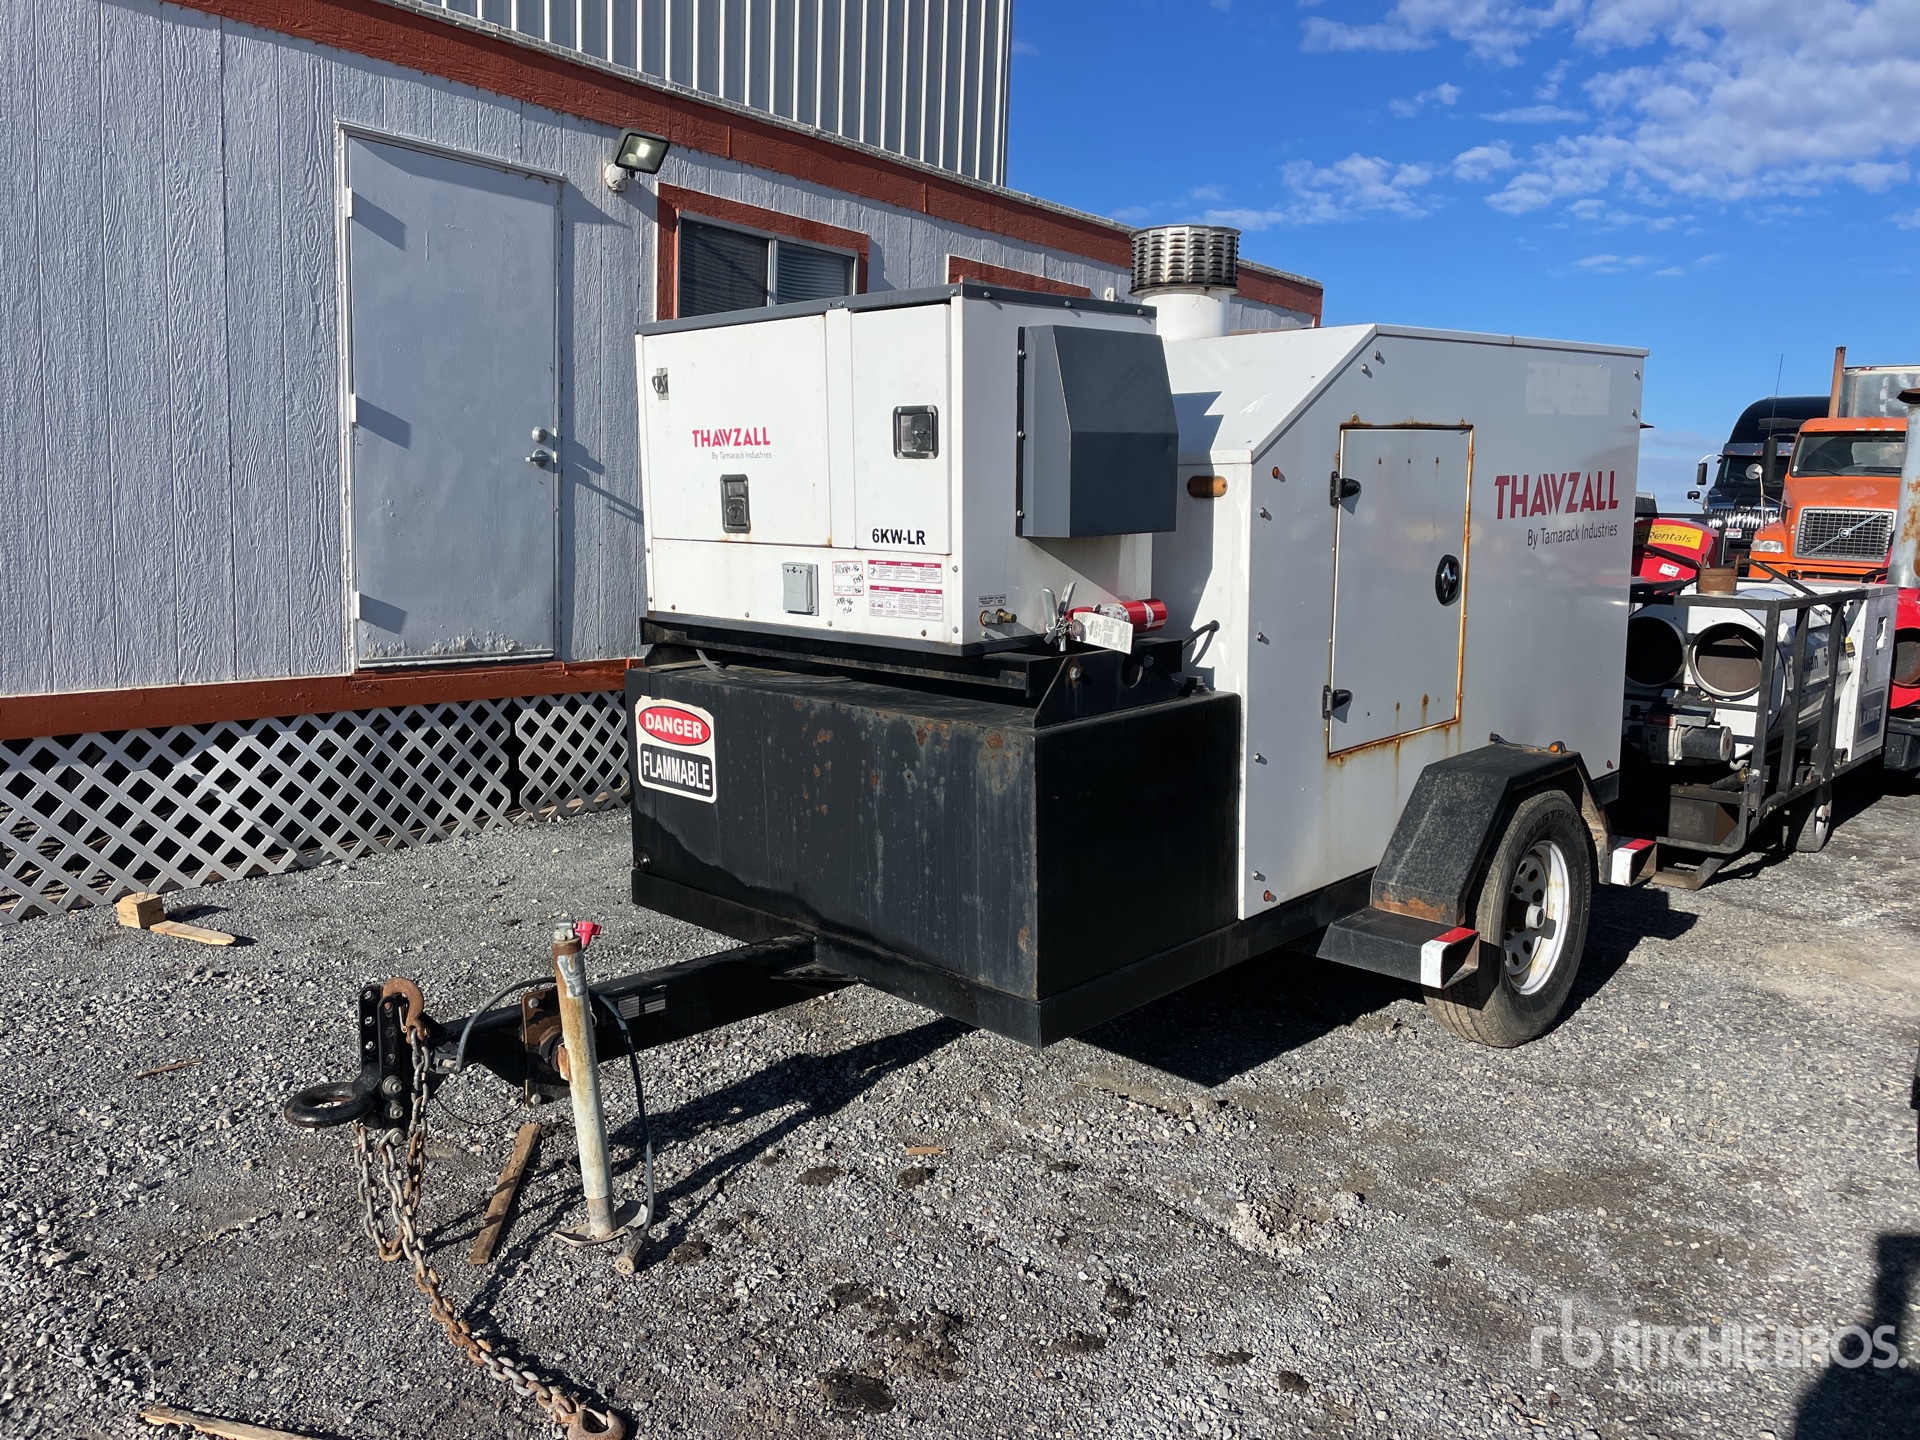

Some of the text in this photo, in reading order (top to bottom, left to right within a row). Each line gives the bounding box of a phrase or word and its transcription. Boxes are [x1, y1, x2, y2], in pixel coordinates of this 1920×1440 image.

[692, 426, 771, 448] THAWZALL
[711, 450, 772, 461] By Tamarack Industries
[1494, 470, 1619, 519] THAWZALL
[872, 528, 926, 546] 6KW-LR
[1527, 521, 1618, 550] By Tamarack Industries
[645, 712, 703, 740] DANGER
[643, 750, 711, 791] FLAMMABLE
